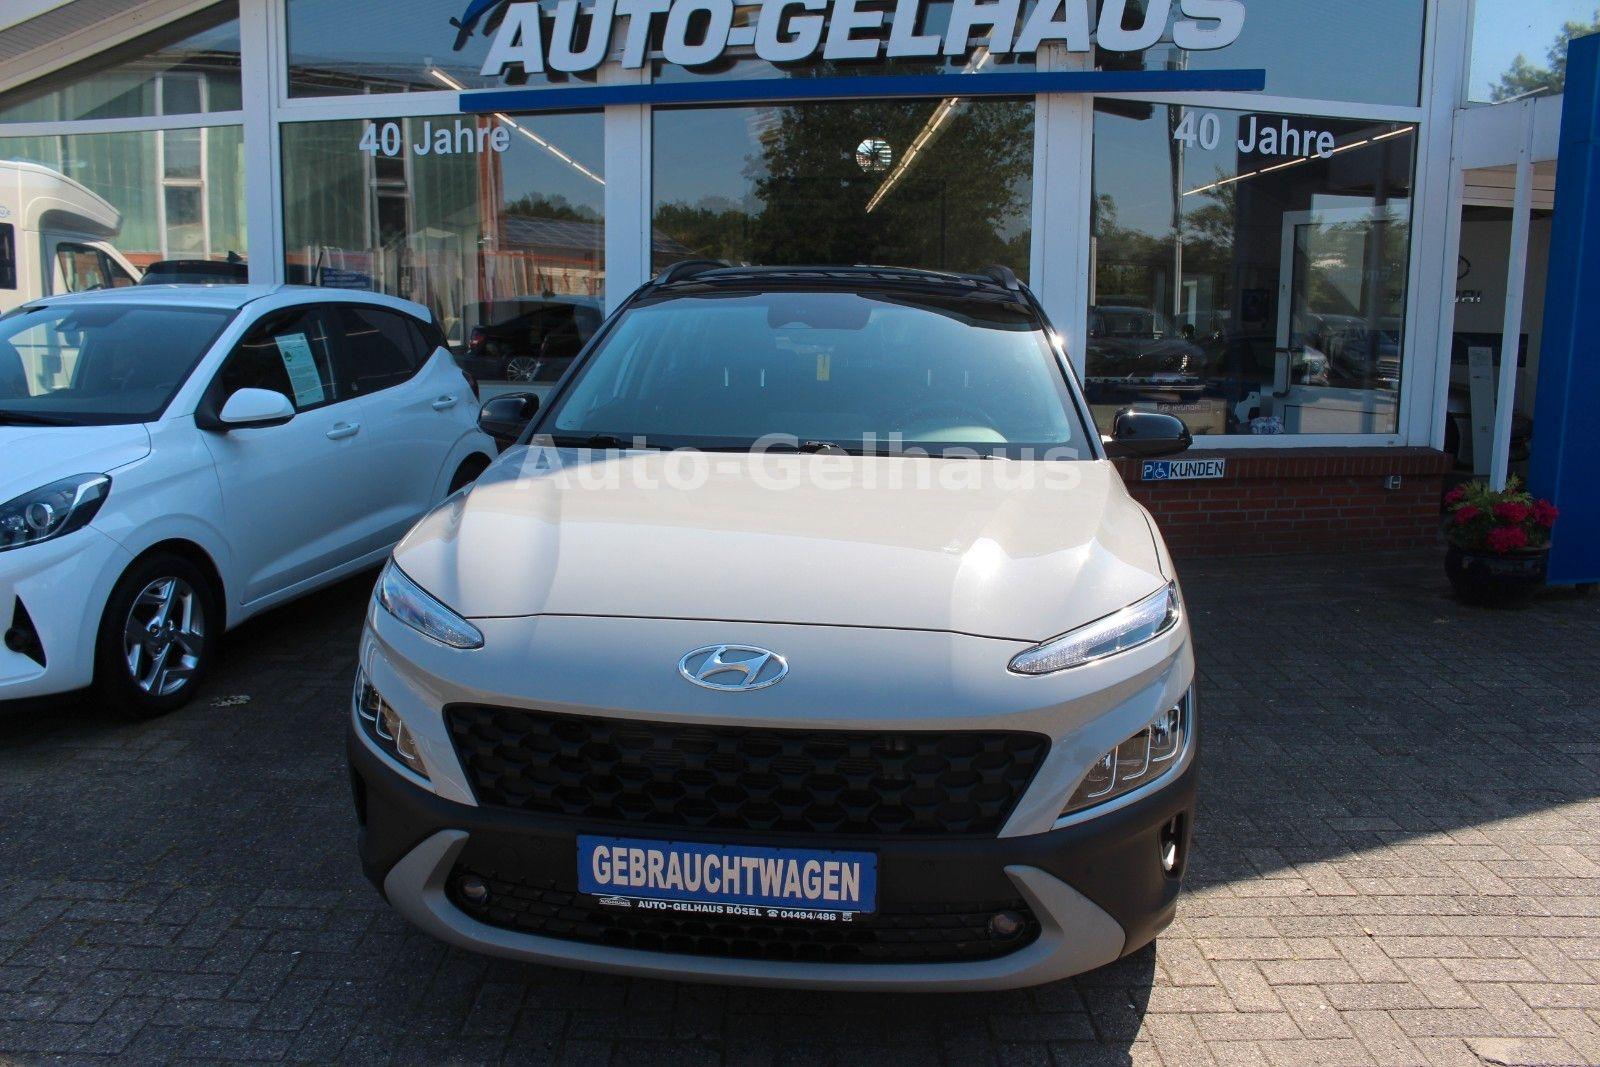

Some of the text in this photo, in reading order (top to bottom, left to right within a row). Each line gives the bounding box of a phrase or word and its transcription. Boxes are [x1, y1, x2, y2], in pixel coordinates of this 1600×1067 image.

[480, 0, 1246, 76] AUTO-GELHAUS
[358, 119, 510, 157] 40 Jahre
[1173, 111, 1335, 159] 40 Jahre
[1144, 462, 1224, 477] P KUNDEN
[592, 845, 861, 901] GEBRAUCHTWAGEN
[638, 900, 724, 914] AUTO-GELHAUS
[726, 904, 762, 917] BÖSEL
[780, 909, 837, 921] 04494/486
